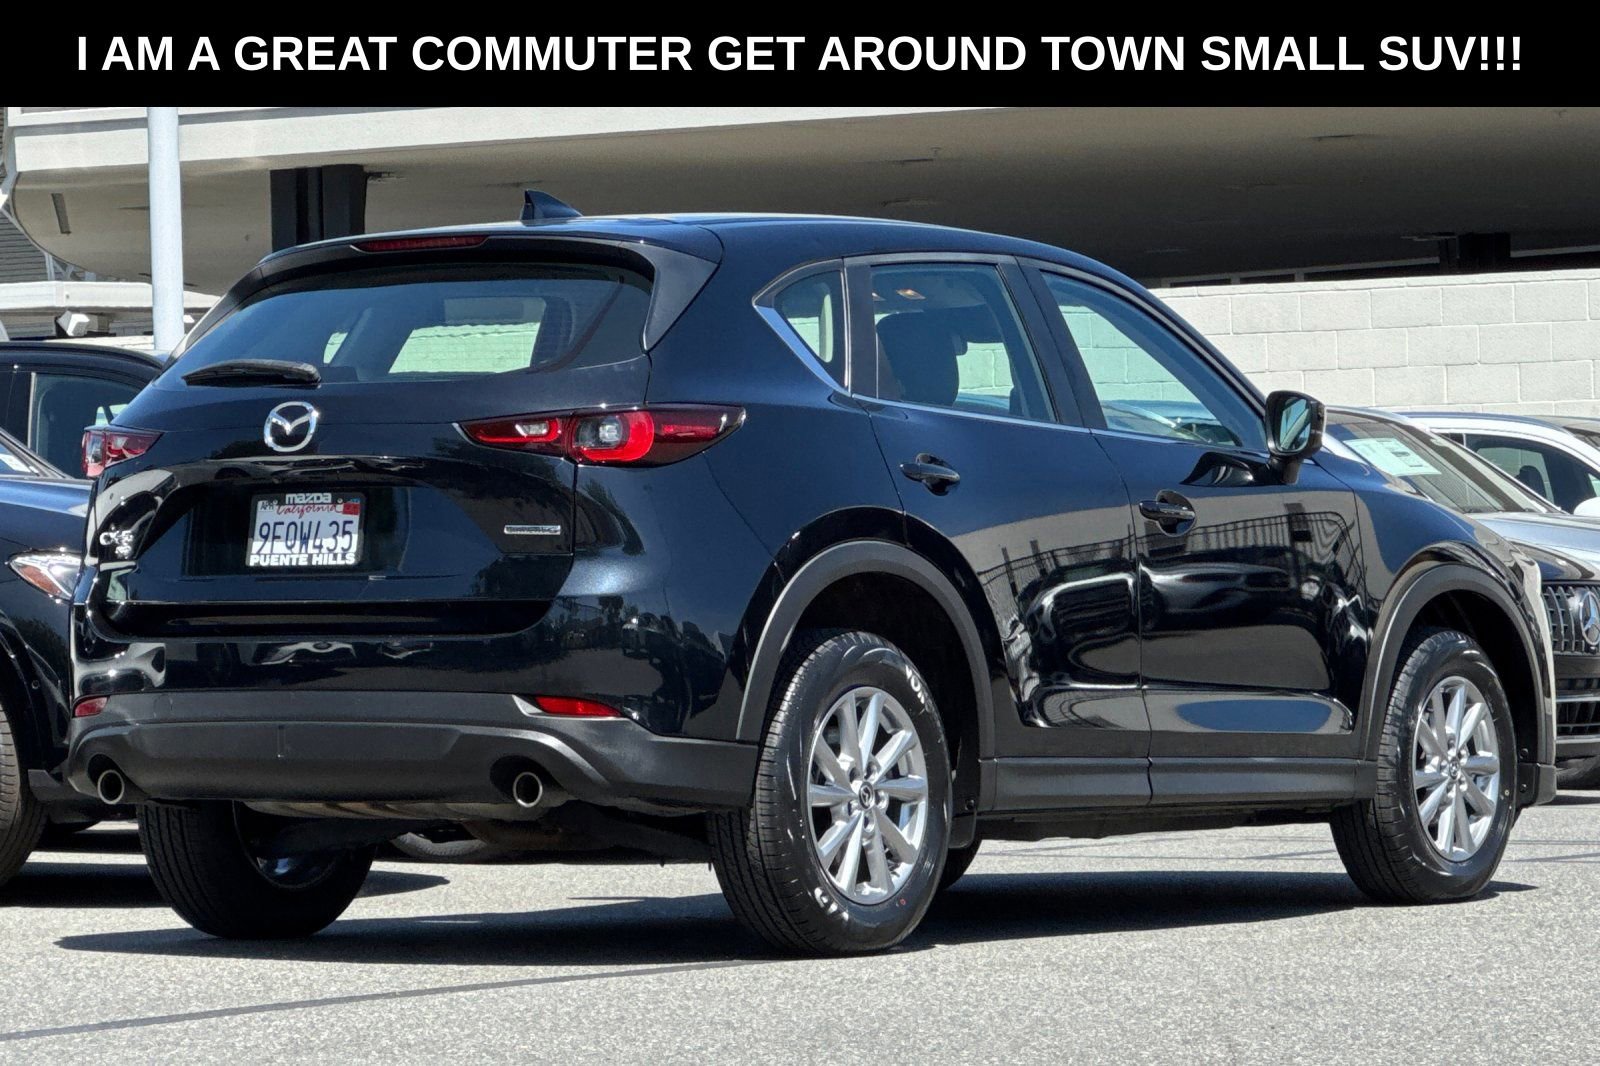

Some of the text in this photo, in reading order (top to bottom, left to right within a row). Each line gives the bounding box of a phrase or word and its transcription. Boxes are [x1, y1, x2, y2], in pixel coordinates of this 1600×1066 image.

[256, 519, 354, 554] 9FQW435
[249, 552, 356, 567] PUENTE HILLS
